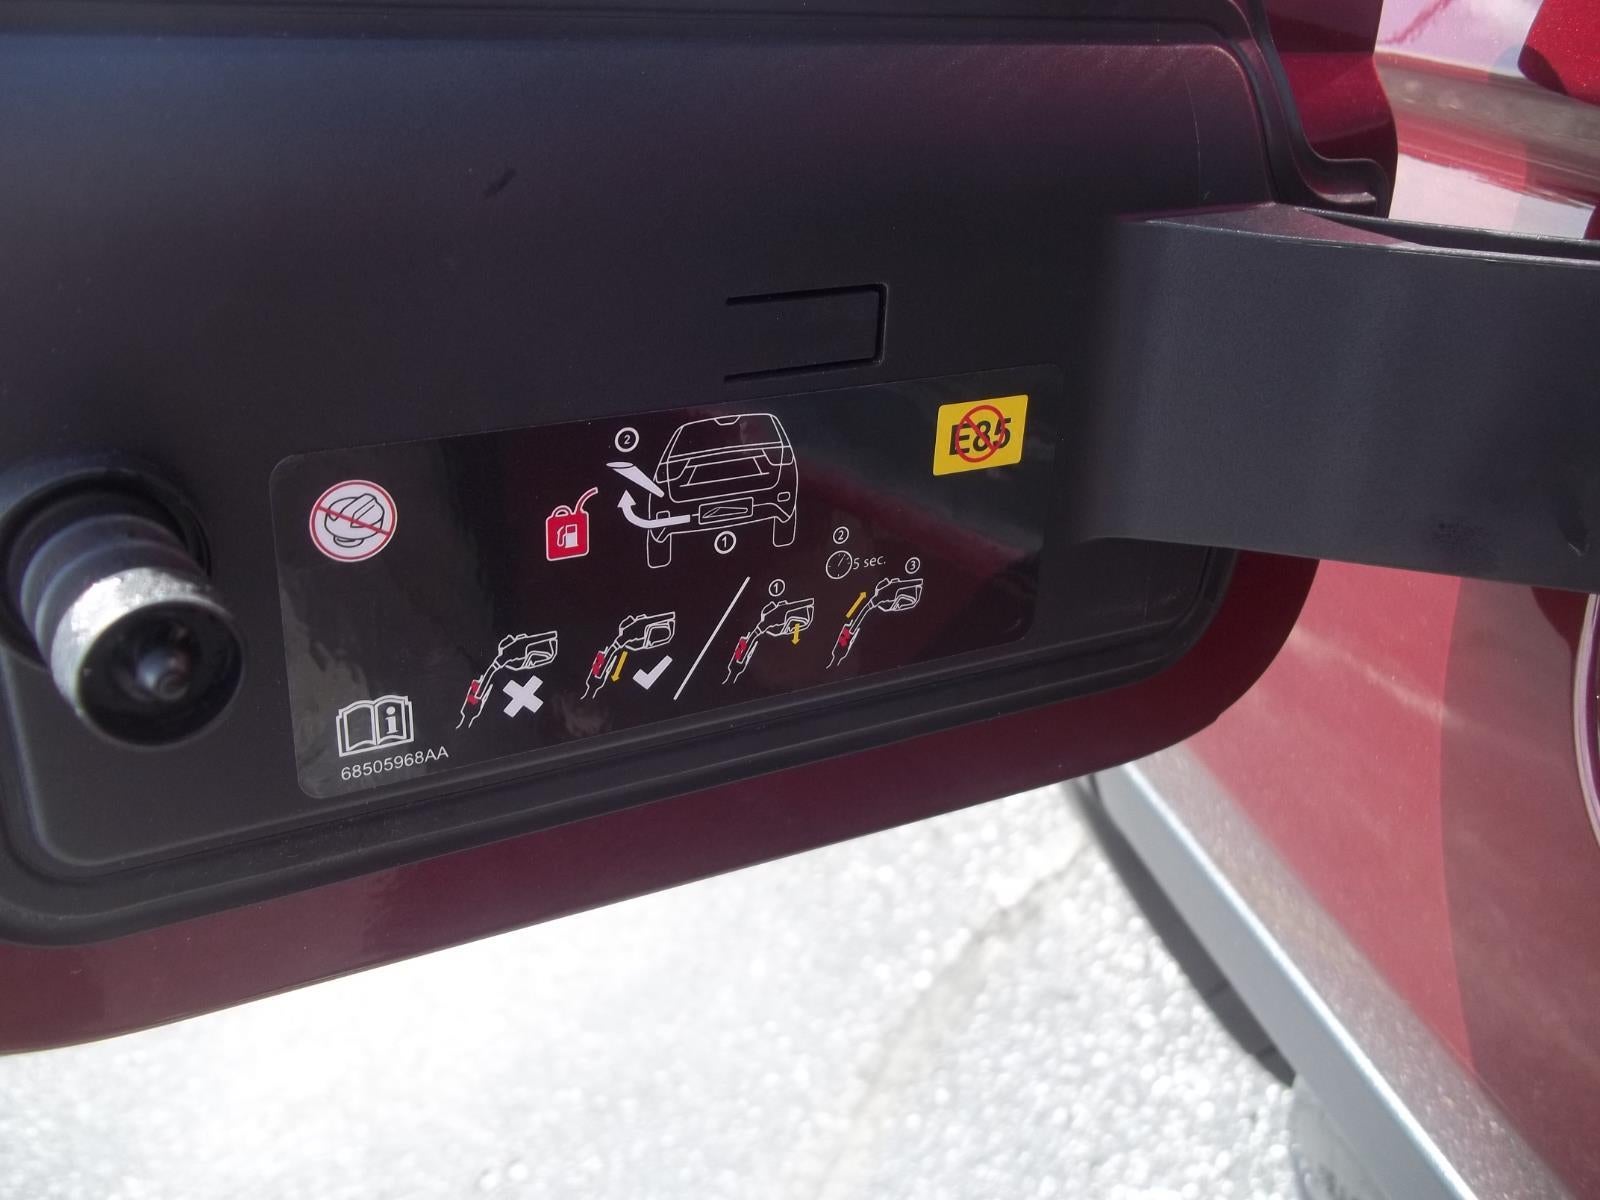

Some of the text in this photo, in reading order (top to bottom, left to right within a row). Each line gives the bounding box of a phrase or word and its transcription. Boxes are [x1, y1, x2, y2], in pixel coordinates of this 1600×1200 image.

[624, 434, 631, 445] 2
[949, 417, 1011, 455] E85
[837, 530, 844, 541] 2
[852, 555, 886, 570] 5 sec.
[910, 560, 916, 570] 3
[341, 745, 449, 780] 68505968AA
